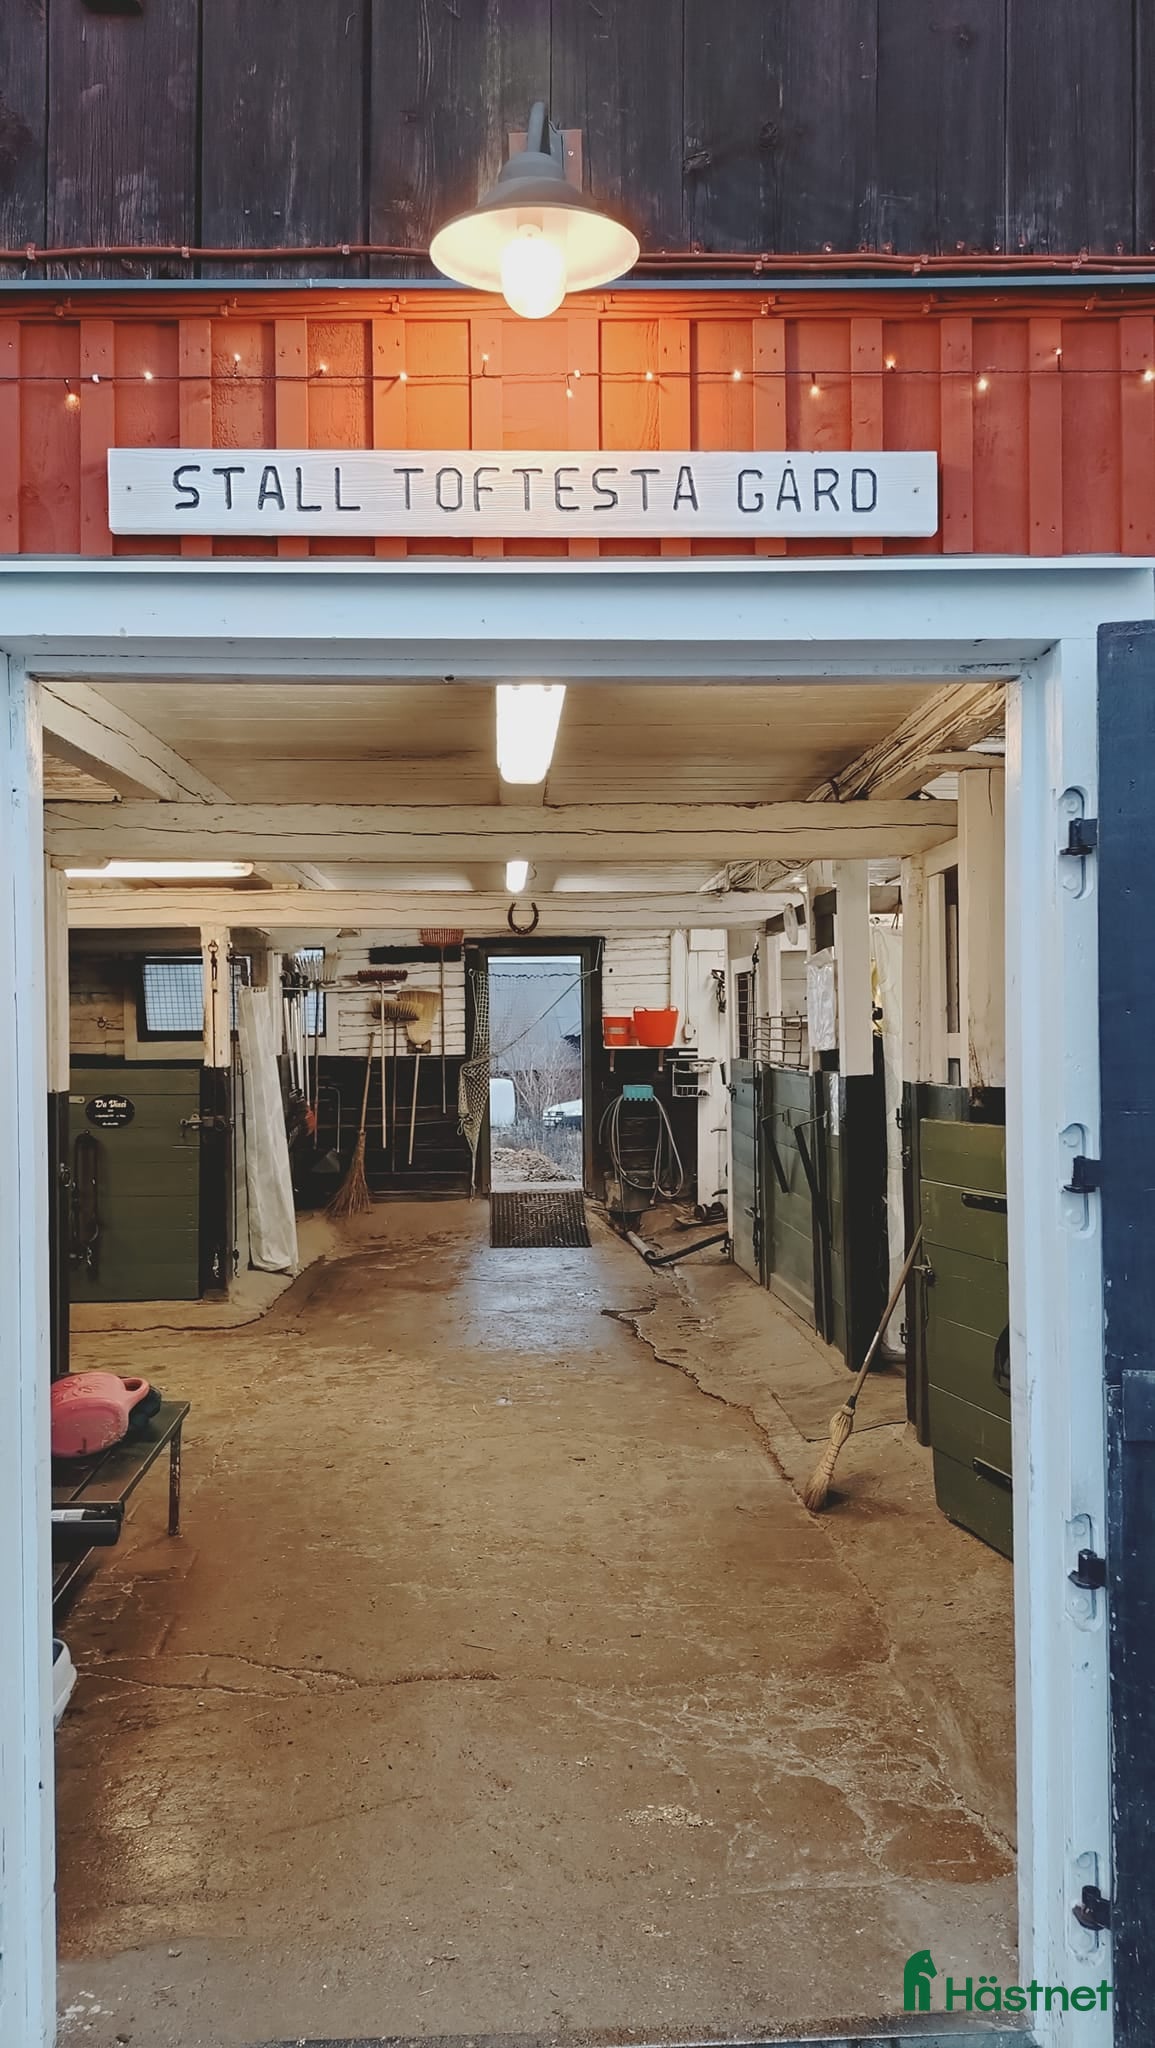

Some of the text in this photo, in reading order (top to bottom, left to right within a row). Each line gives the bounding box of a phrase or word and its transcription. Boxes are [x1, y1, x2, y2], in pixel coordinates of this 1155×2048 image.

[173, 459, 878, 513] STALL TOFTESTA GÅRD
